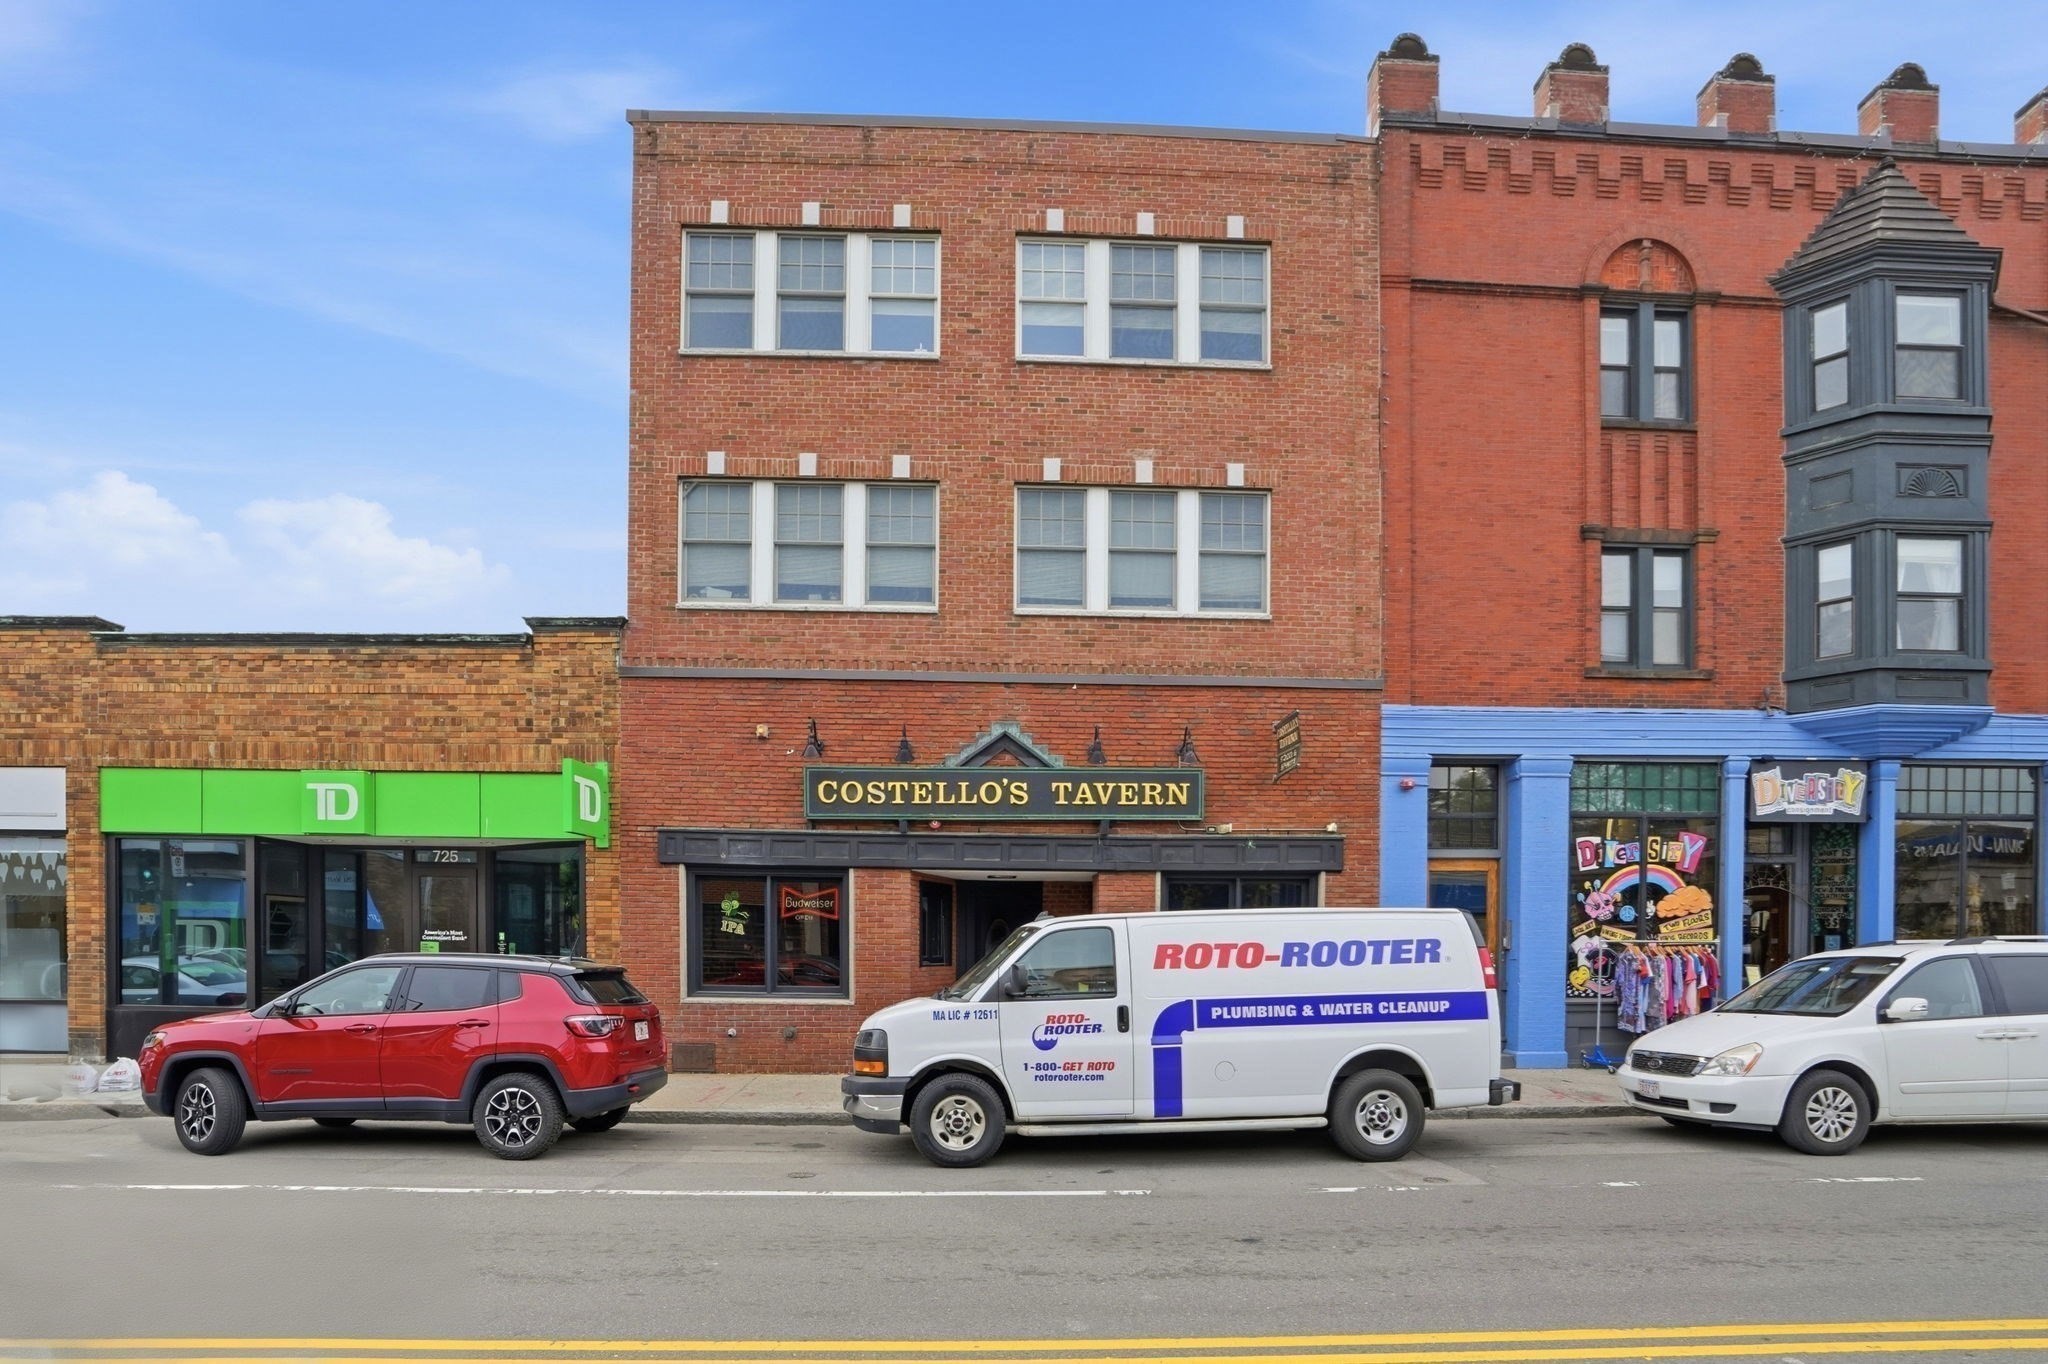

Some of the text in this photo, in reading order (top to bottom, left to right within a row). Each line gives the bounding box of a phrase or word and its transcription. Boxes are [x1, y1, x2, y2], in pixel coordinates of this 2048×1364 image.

[817, 778, 1191, 805] COSTELLO'S TAVERN
[306, 783, 359, 821] TD
[574, 774, 601, 823] TD
[433, 850, 459, 863] 725
[785, 896, 835, 908] Budweiser
[720, 920, 745, 936] IPA
[1663, 921, 1681, 931] TWO
[1152, 938, 1442, 970] ROTO-ROOTER
[933, 1009, 998, 1021] MA LIC # 12611
[1211, 1000, 1451, 1019] PLUMBING & WATER CLEANUP
[1046, 1013, 1090, 1025] ROTO-
[1044, 1023, 1103, 1035] ROOTER
[1024, 1061, 1115, 1072] 1-800-GET ROTO
[1034, 1073, 1105, 1082] rotorooter.com
